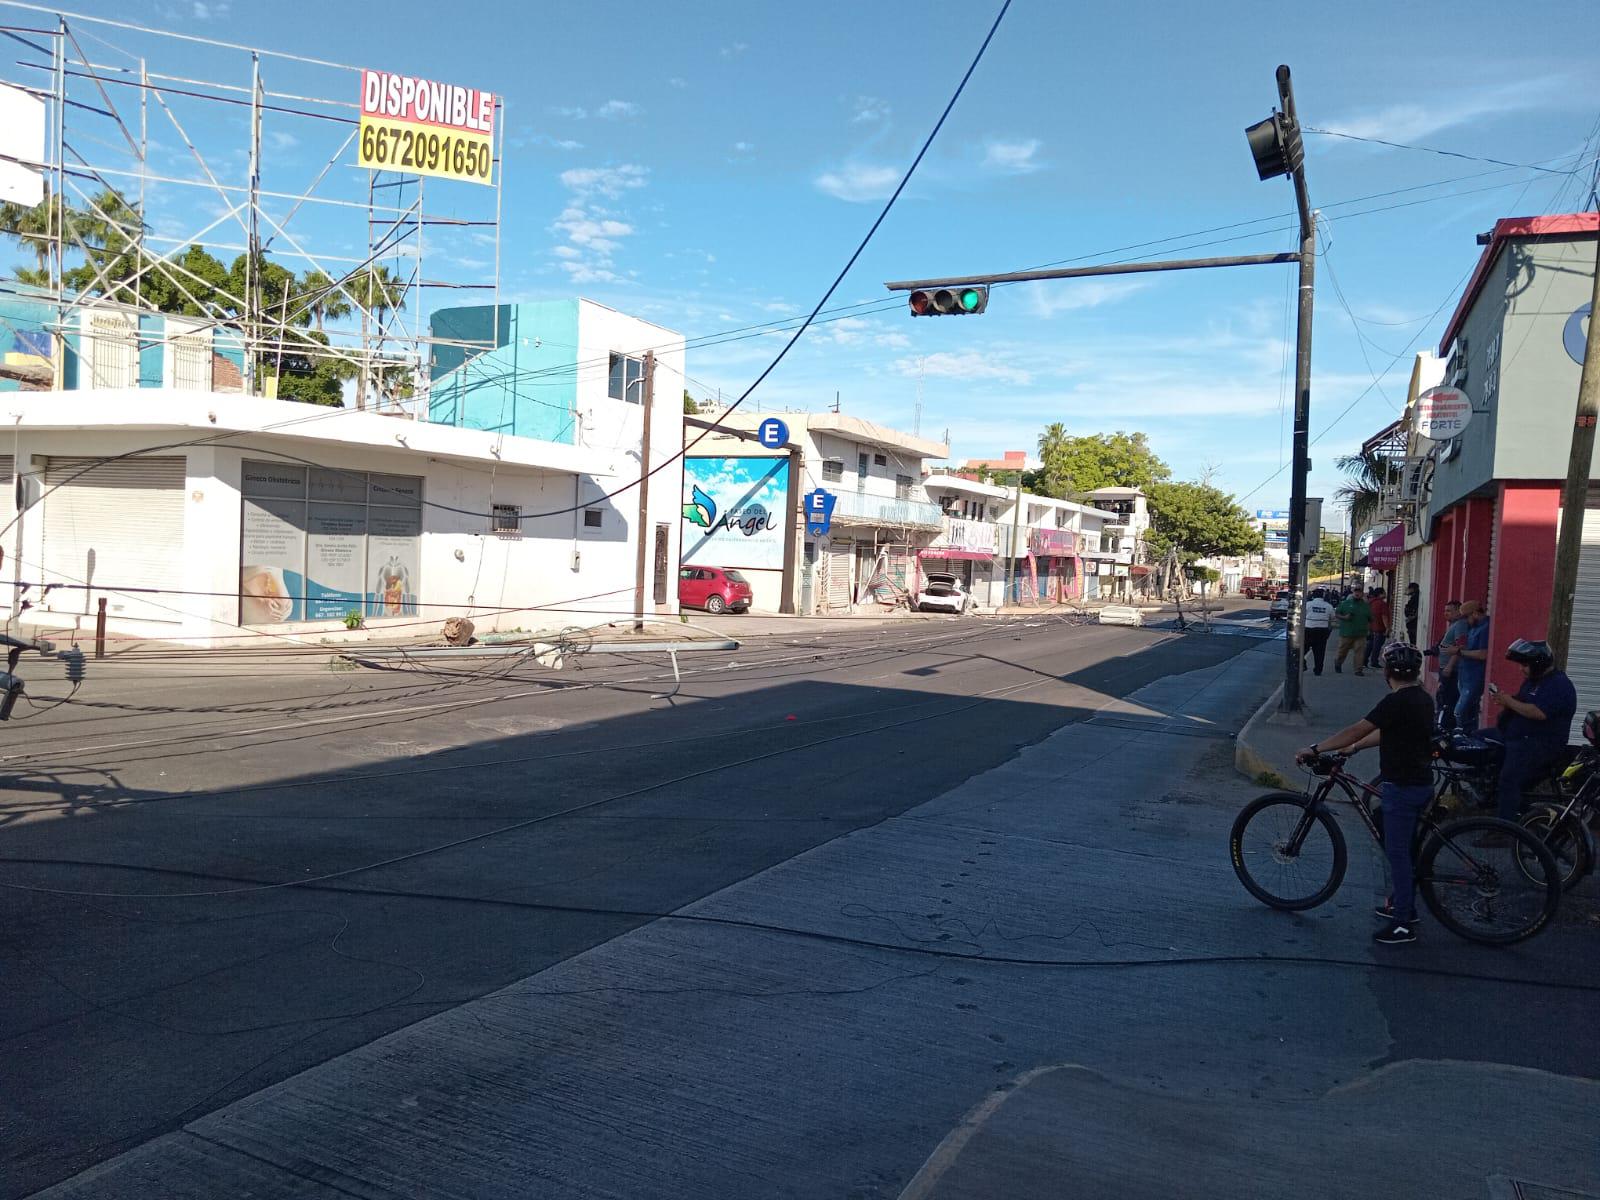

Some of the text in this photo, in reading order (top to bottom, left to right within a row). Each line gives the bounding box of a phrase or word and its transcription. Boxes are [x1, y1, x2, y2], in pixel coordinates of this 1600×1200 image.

[364, 71, 492, 132] DISPONIBLE
[362, 124, 490, 178] 6672091650
[764, 424, 779, 442] E
[1421, 420, 1462, 430] FORTE
[813, 494, 825, 508] E
